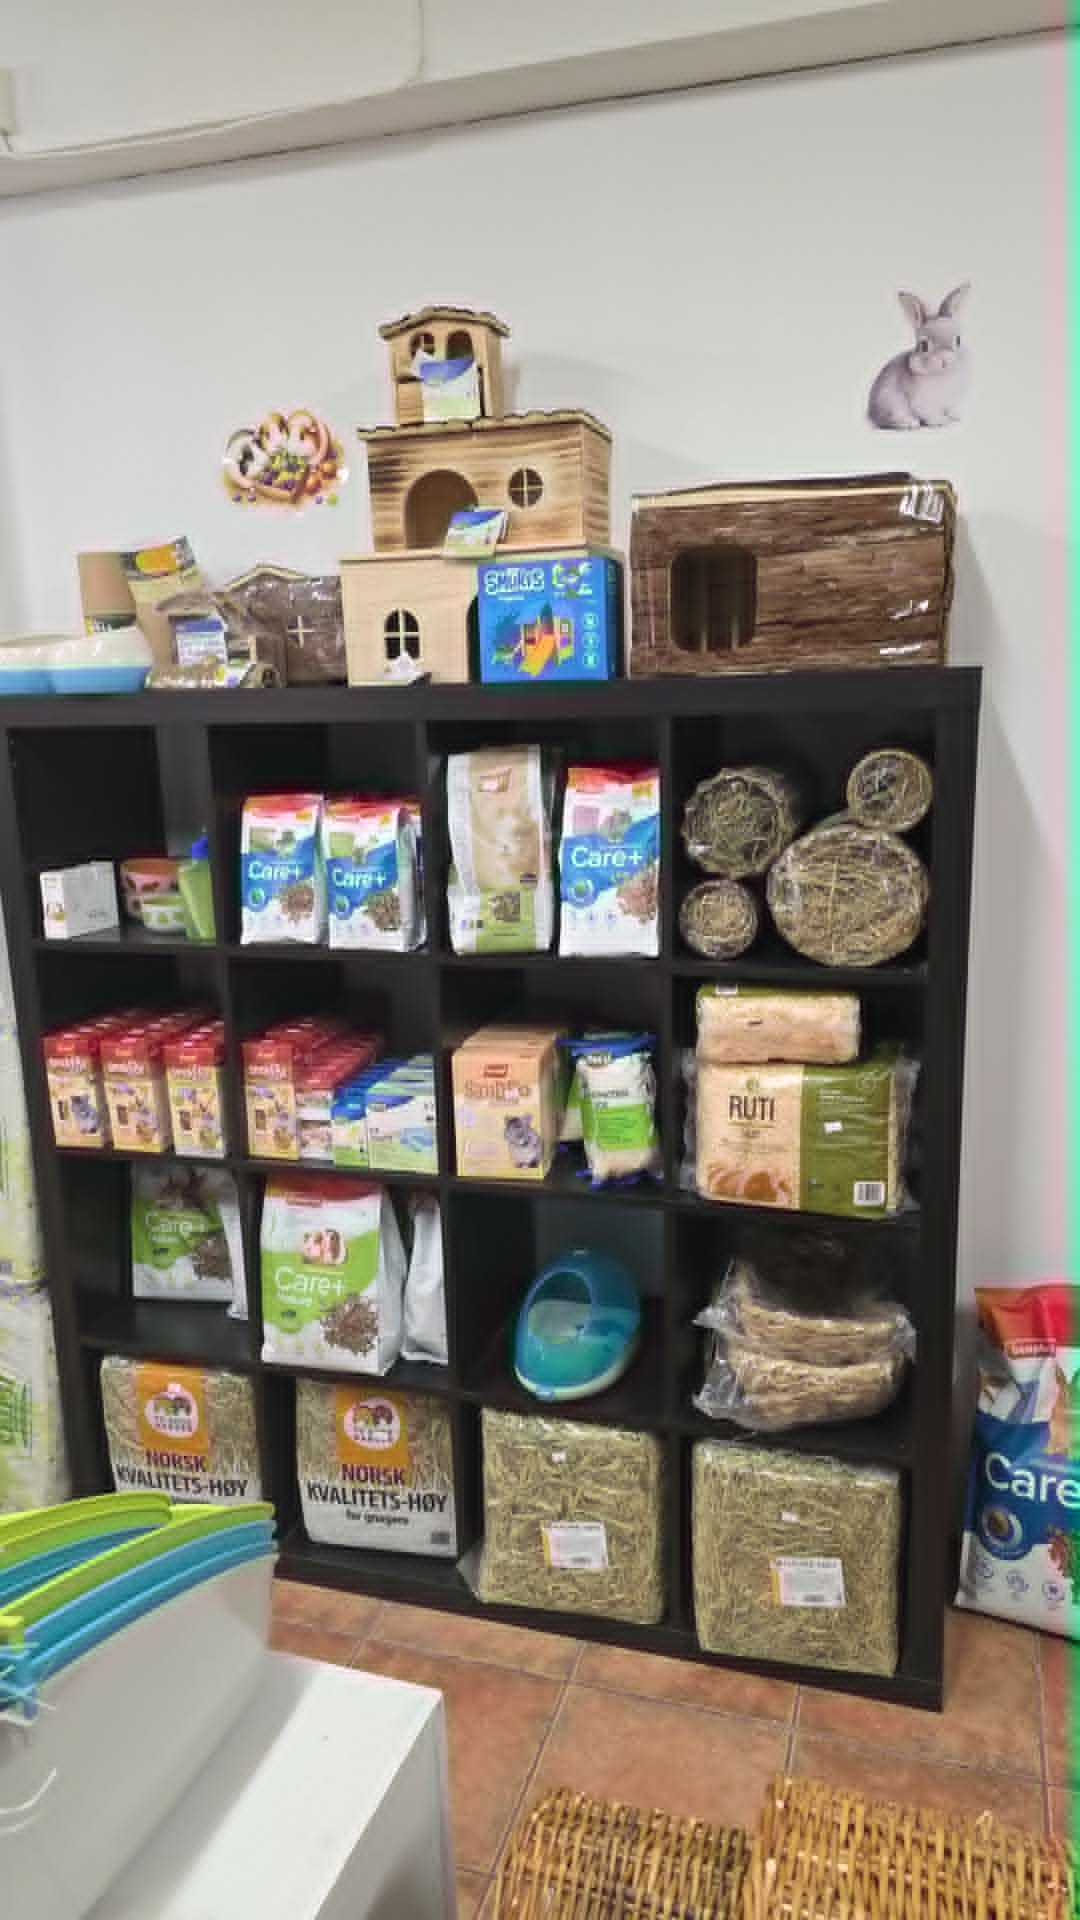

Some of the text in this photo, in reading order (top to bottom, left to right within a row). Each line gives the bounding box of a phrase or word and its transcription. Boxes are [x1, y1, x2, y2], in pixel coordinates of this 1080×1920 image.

[571, 846, 643, 868] Care+
[729, 1095, 775, 1121] RUTI
[274, 1265, 347, 1296] Care+
[145, 1449, 207, 1473] NORSK
[115, 1463, 249, 1497] KVALITETS-HØY
[342, 1463, 406, 1487] NORSK
[306, 1480, 448, 1513] KVALITETS-HØY
